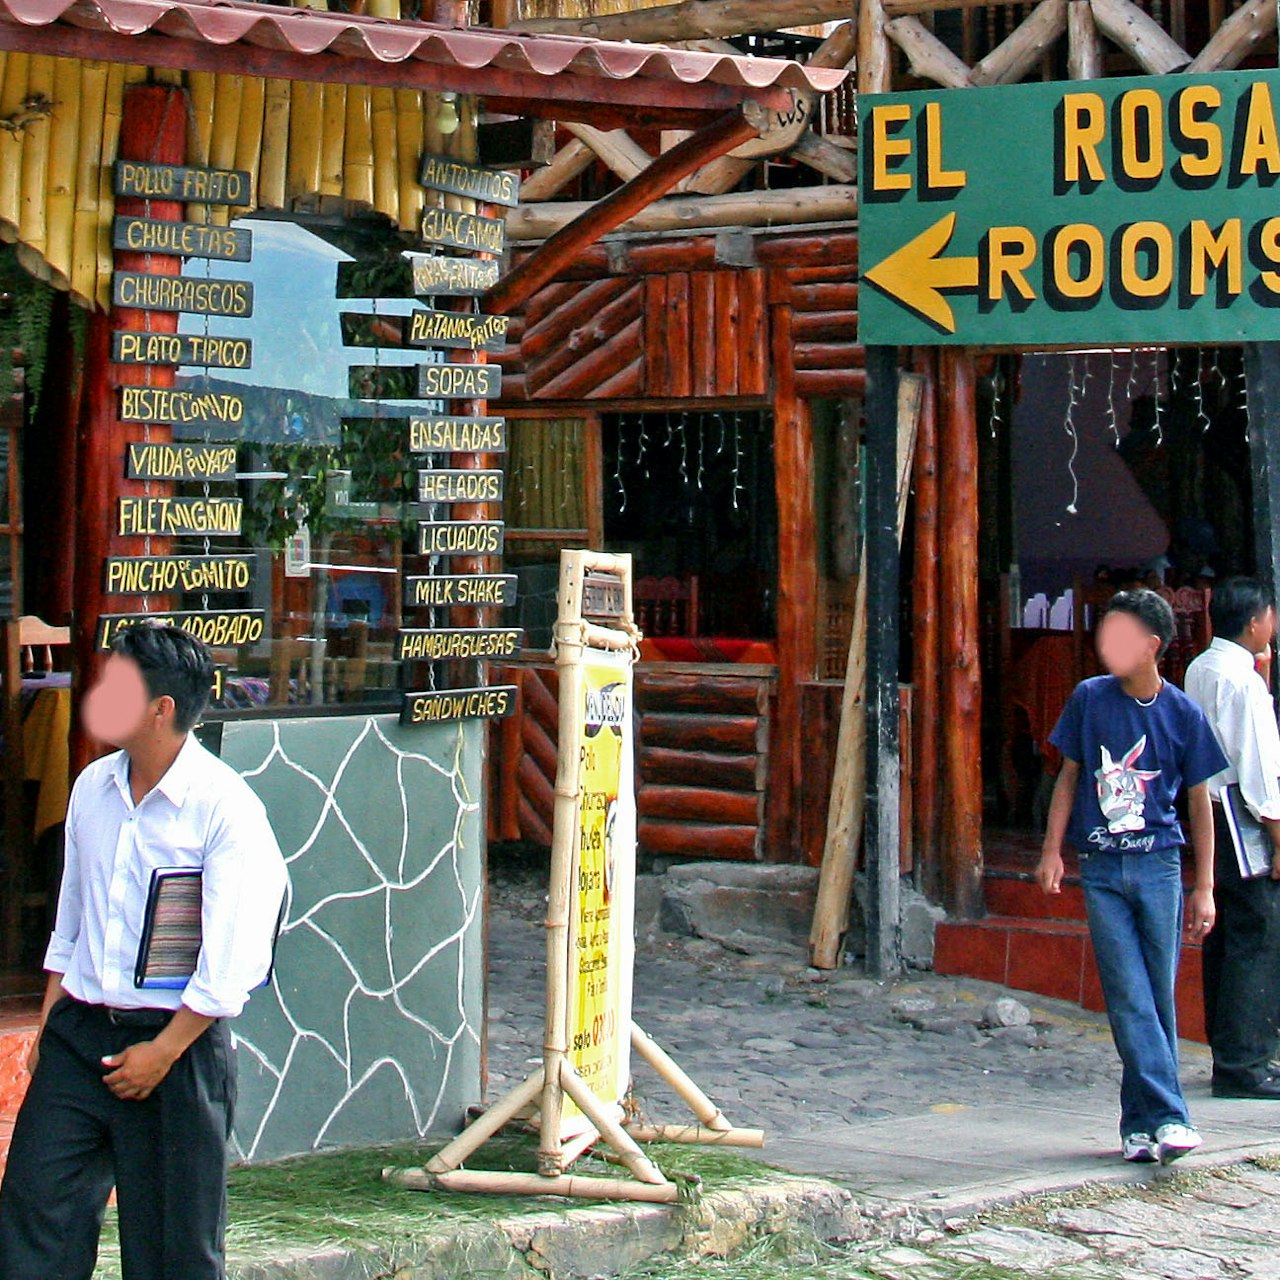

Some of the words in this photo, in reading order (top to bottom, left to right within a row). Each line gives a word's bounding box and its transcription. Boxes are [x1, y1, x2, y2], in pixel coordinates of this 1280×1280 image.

[870, 102, 966, 192] EL
[122, 164, 171, 195] POLLO
[183, 170, 241, 200] FRITO
[424, 158, 513, 200] ANTOJITOS
[127, 221, 238, 257] CHULETAS
[422, 210, 503, 253] GUACAMOL
[120, 276, 248, 314] CHURRASCOS
[411, 312, 472, 342] PLATANOS
[470, 315, 509, 349] FRITOS
[121, 334, 181, 362] PLATO
[188, 337, 247, 367] TIPICO
[427, 367, 489, 396] SOPAS
[122, 388, 178, 420] BISTEC
[410, 421, 502, 450] ENSALADAS
[130, 445, 184, 477] VIUDA
[424, 475, 499, 501] HELADOS
[119, 498, 171, 535] FILET
[422, 525, 499, 554] LICUADOS
[108, 561, 178, 592] PINCHO
[181, 560, 250, 591] LOMITO
[415, 581, 453, 604] MILK
[457, 579, 506, 604] SHAKE
[401, 632, 517, 660] HAMBURGUESAS
[412, 691, 509, 722] SANDWICHES
